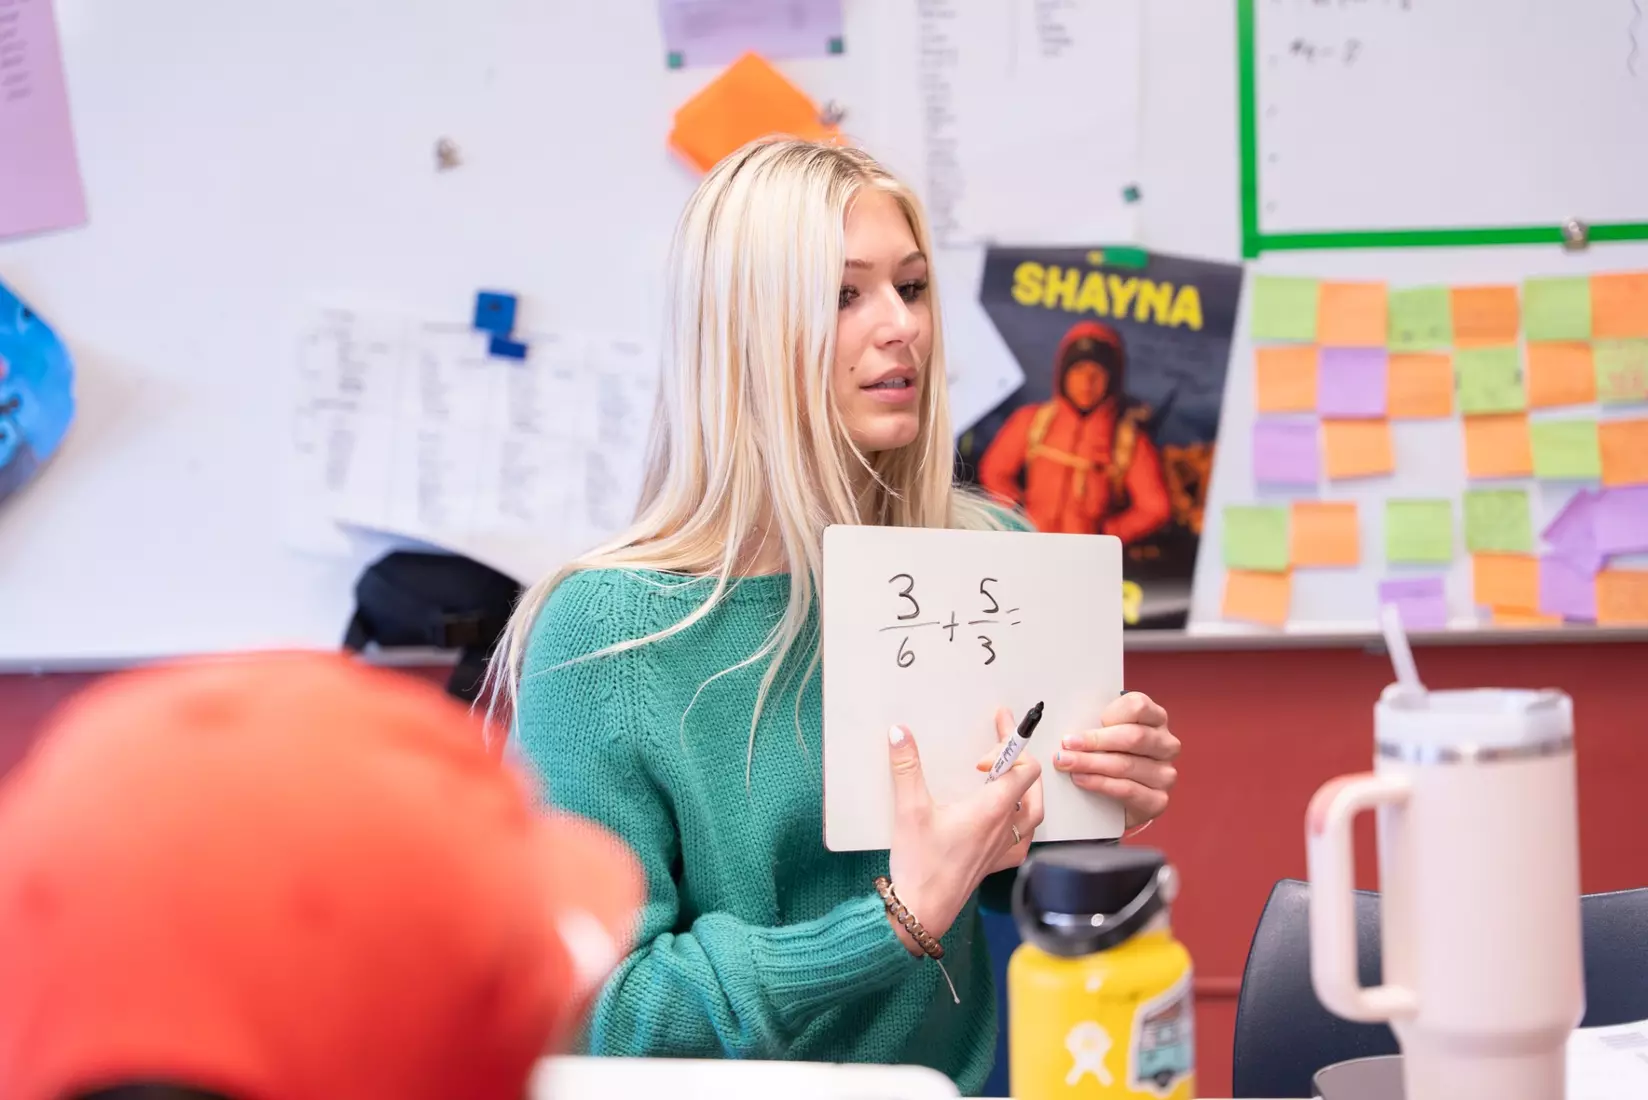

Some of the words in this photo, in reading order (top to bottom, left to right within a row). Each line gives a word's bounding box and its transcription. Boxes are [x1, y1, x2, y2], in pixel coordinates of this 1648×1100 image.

[1012, 261, 1203, 330] SHAYNA
[888, 573, 920, 620] 3
[979, 577, 1000, 613] 5
[896, 636, 916, 668] 6
[977, 635, 996, 665] 3
